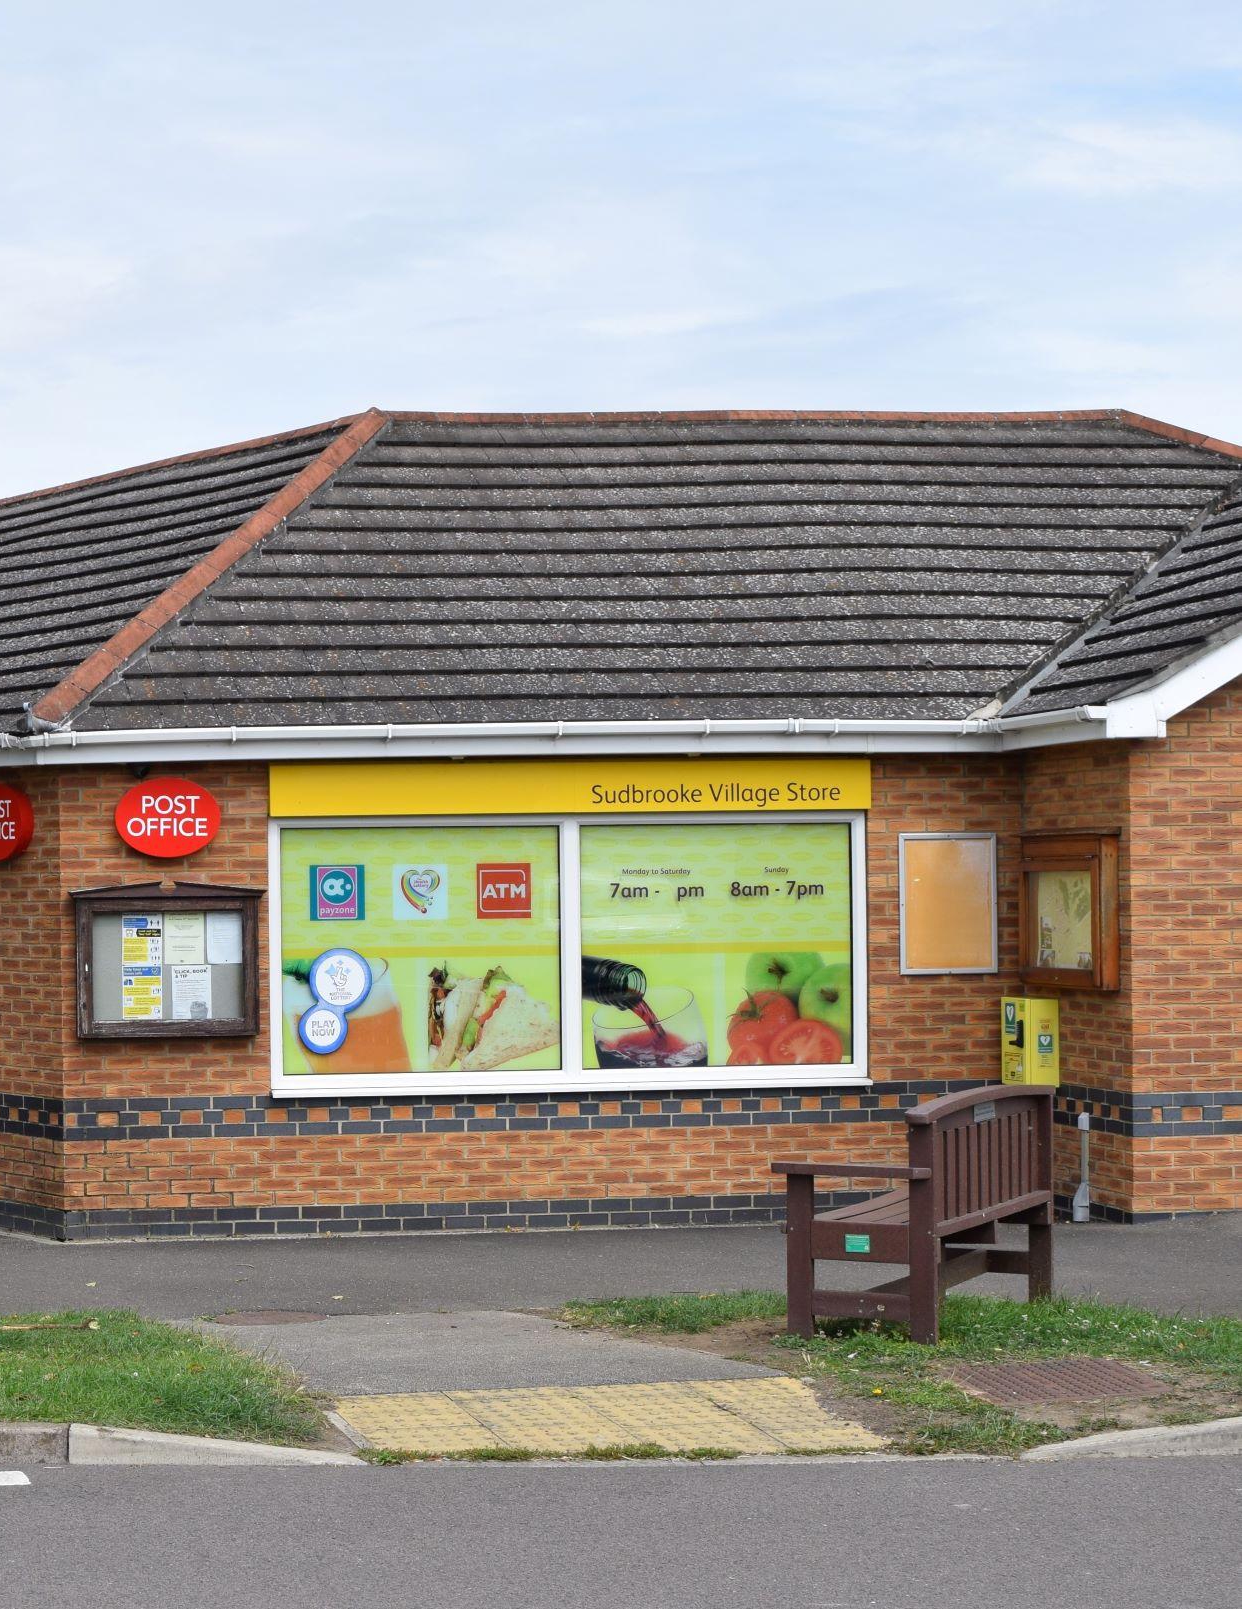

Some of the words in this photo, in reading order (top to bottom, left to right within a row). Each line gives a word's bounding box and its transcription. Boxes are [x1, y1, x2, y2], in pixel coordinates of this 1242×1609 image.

[591, 784, 703, 804] Sudbrooke
[709, 783, 780, 807] Village
[787, 782, 841, 801] Store
[141, 795, 201, 815] POST
[126, 816, 208, 837] OFFICE
[622, 868, 650, 876] Monday
[660, 867, 691, 876] Saturday
[764, 866, 789, 874] Sunday
[482, 883, 526, 899] ATM
[610, 882, 649, 898] 7am
[676, 885, 705, 901] pm
[730, 881, 769, 897] 8am
[786, 880, 824, 900] 7pm
[319, 906, 356, 917] payzone
[311, 1019, 336, 1029] PLAY
[311, 1028, 336, 1037] NOW
